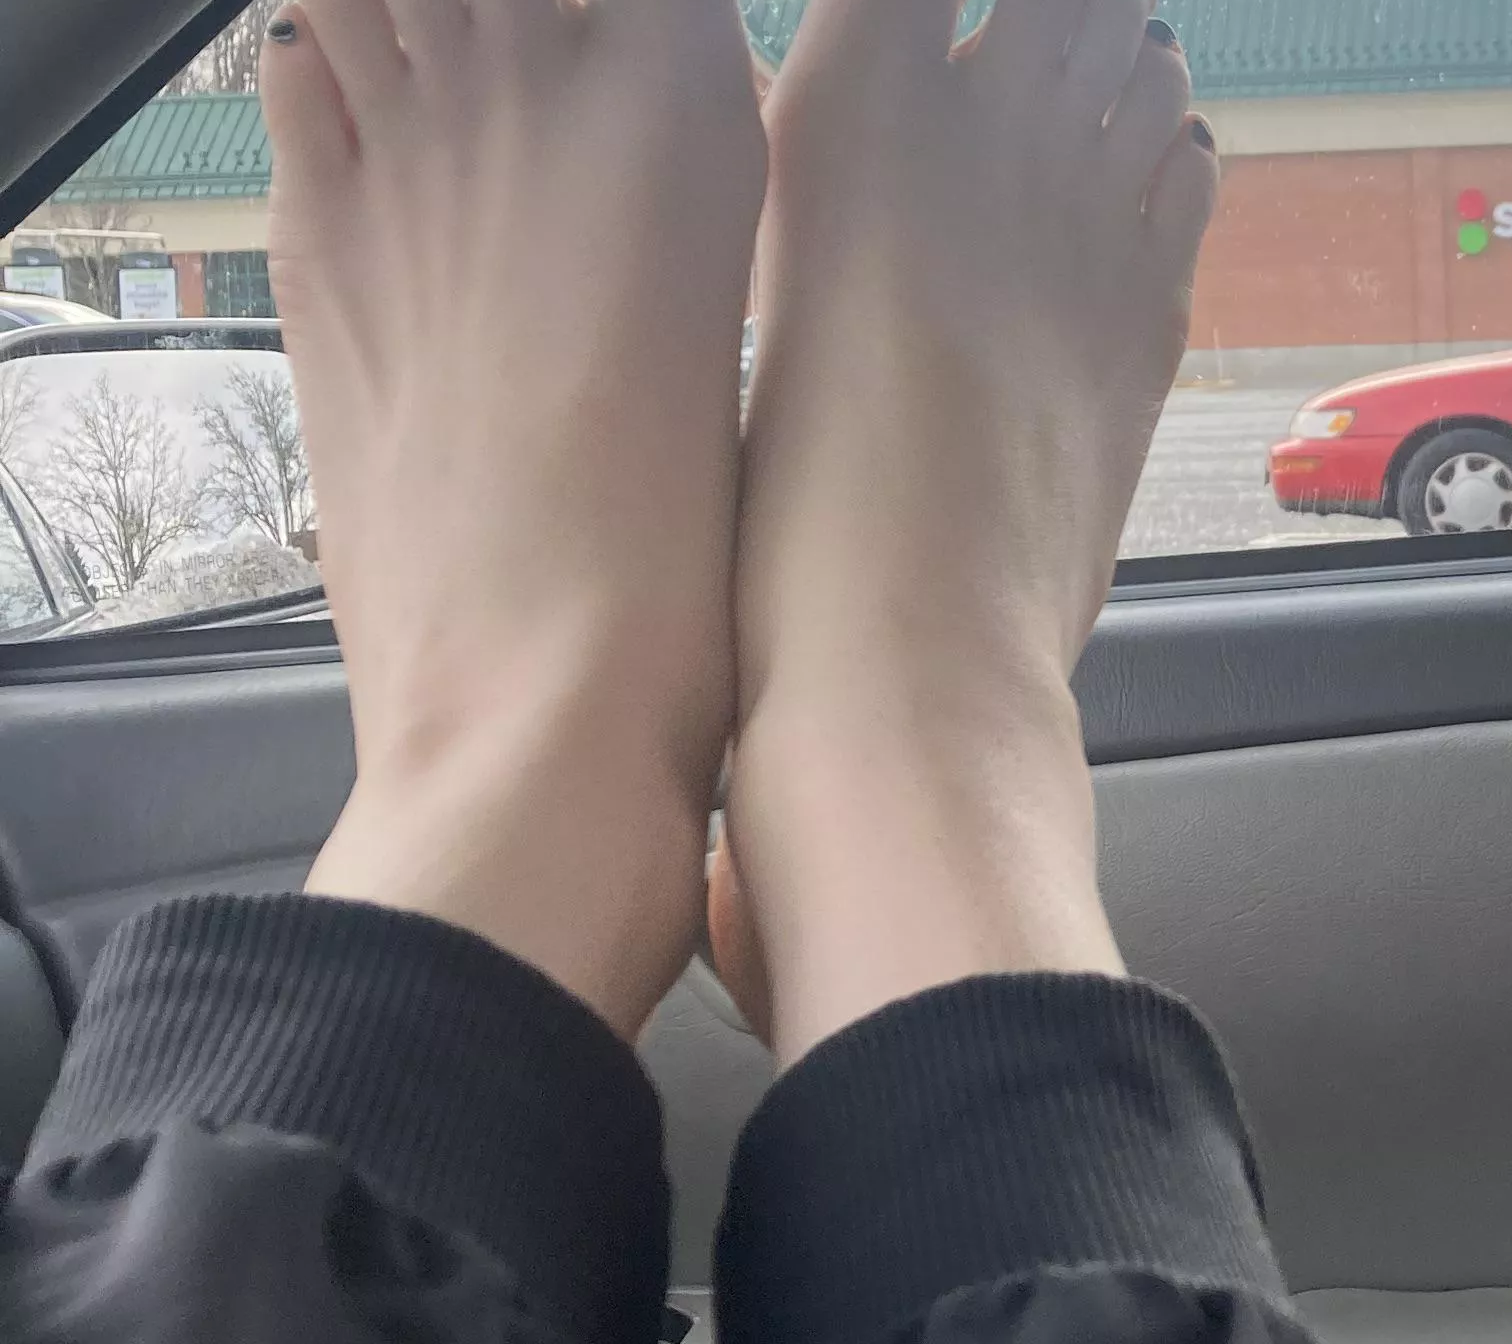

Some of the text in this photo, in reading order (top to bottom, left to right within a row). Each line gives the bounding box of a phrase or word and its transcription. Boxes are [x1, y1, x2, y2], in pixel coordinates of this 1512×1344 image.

[159, 557, 176, 577] IN
[181, 551, 235, 573] MIRROR
[137, 576, 178, 597] THAN
[184, 570, 220, 595] THEY
